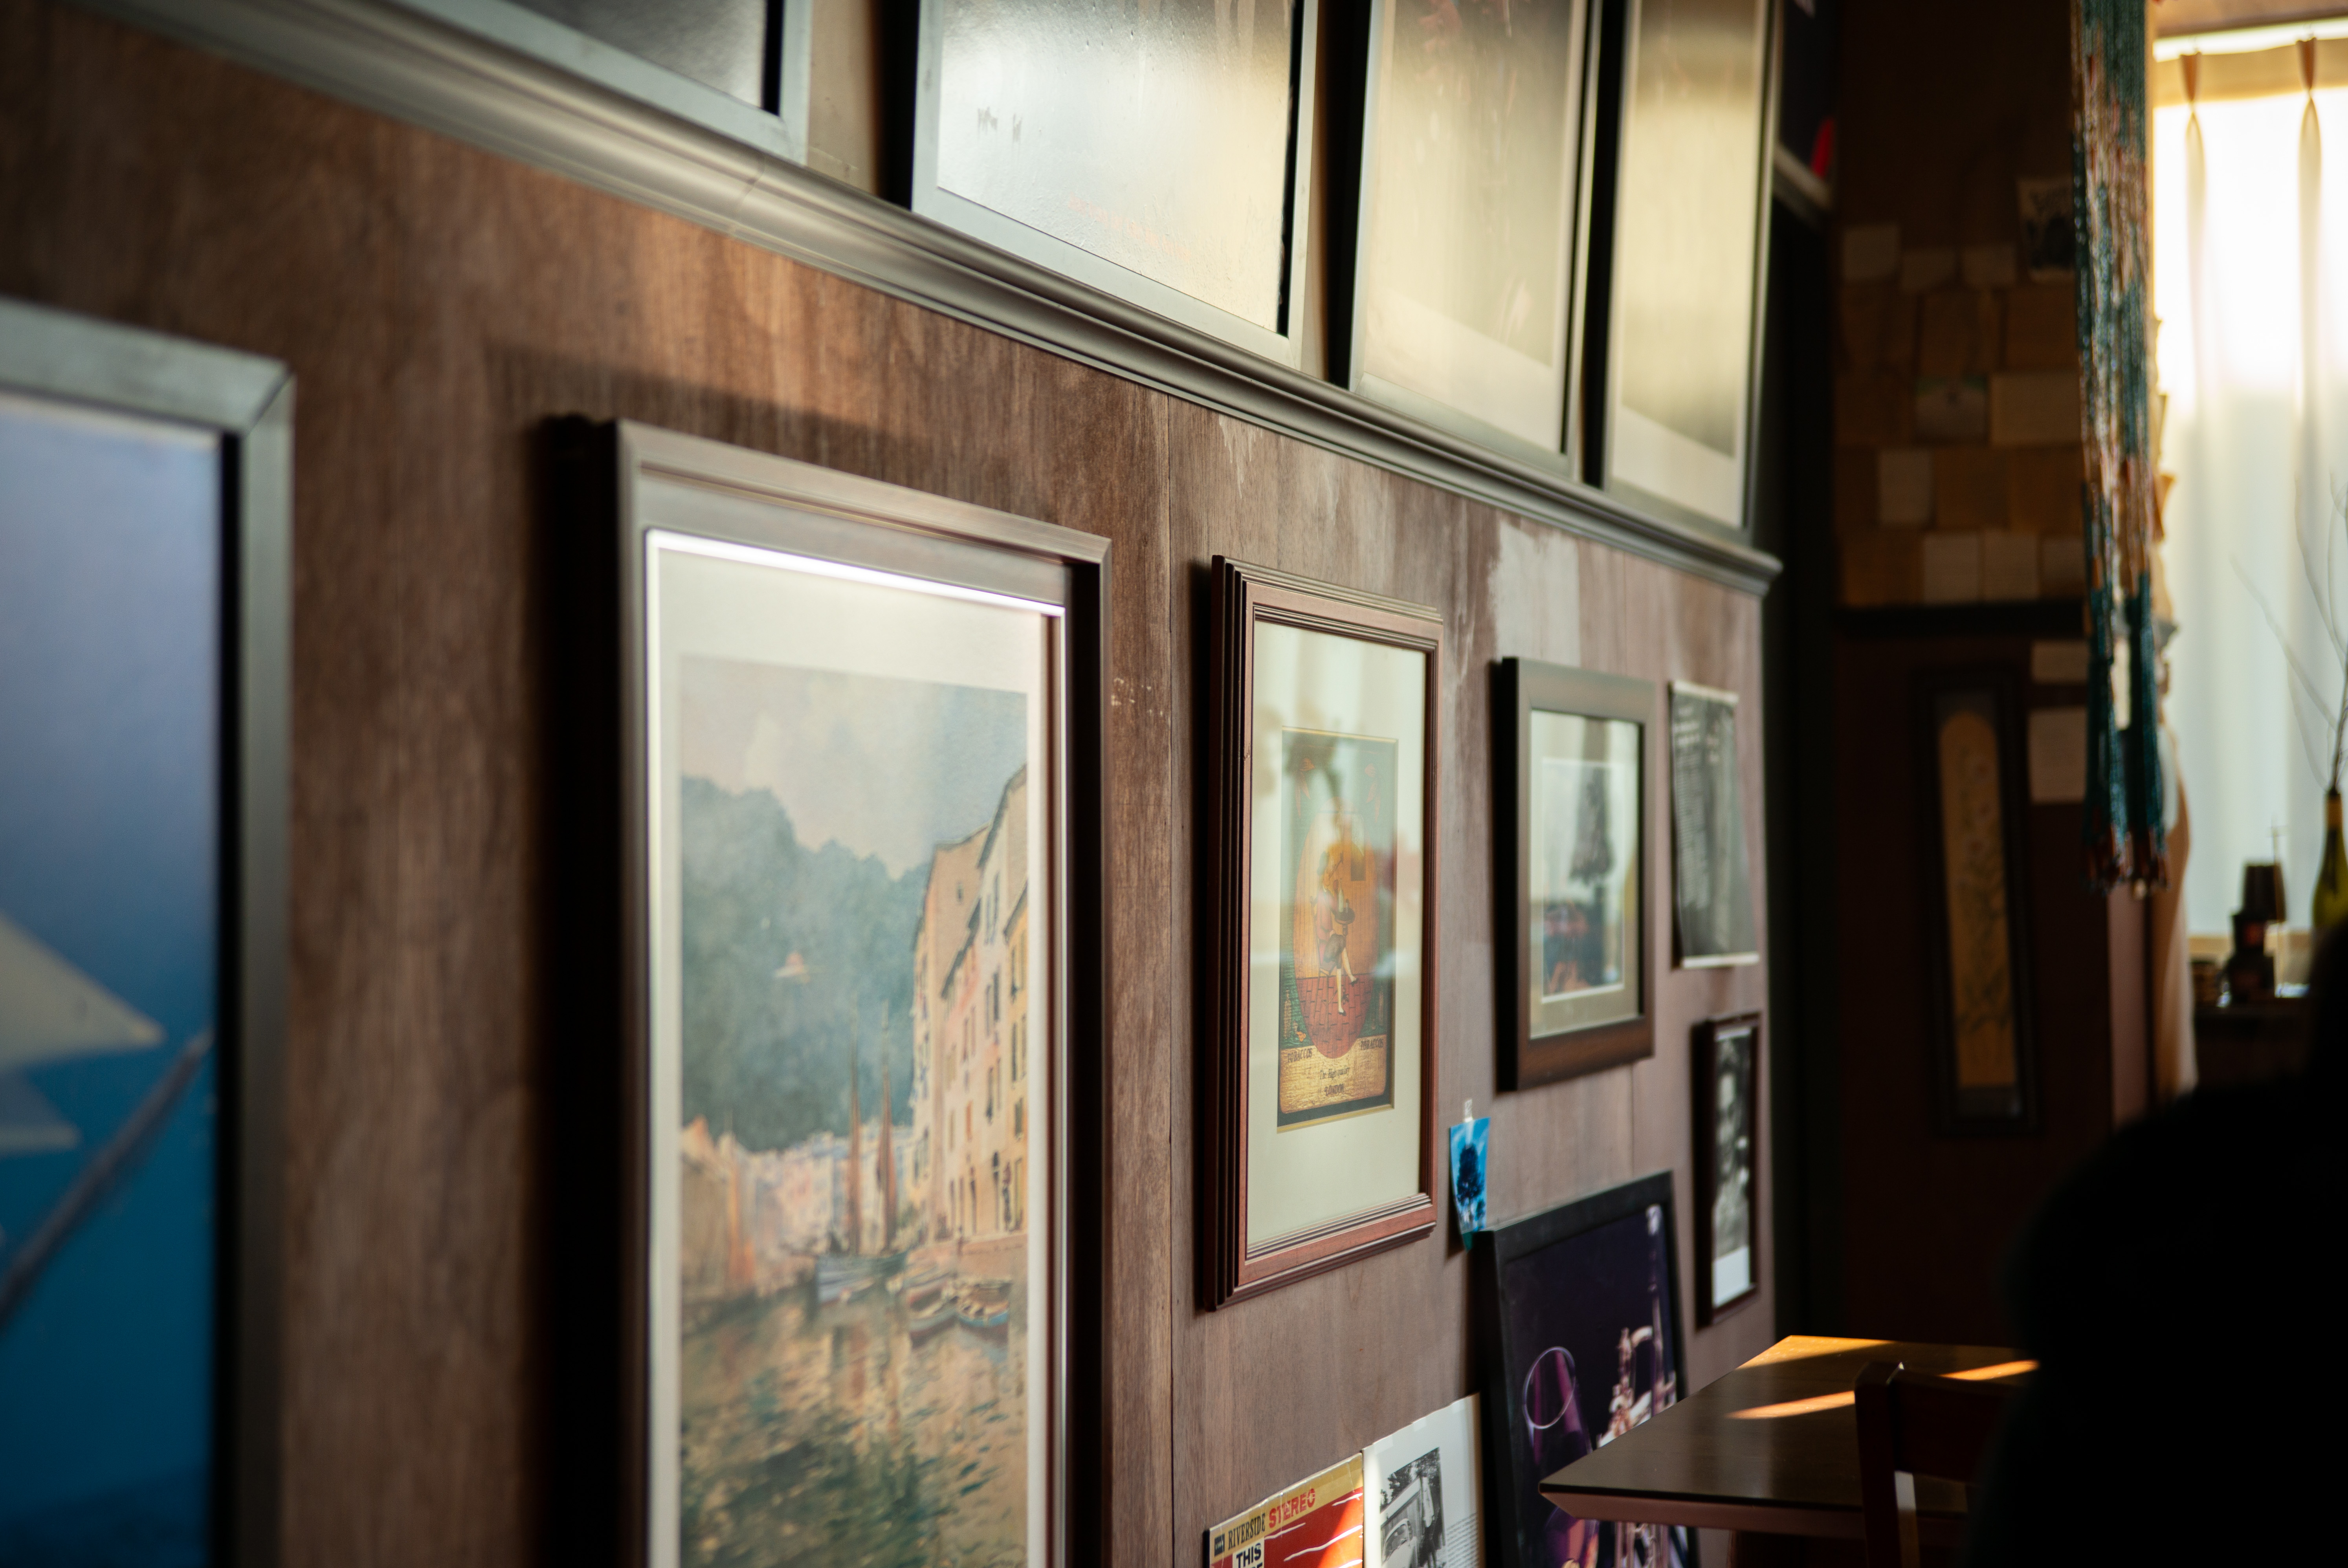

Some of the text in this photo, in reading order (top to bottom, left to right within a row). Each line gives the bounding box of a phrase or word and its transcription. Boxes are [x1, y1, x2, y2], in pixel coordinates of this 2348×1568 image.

[1287, 1048, 1313, 1063] TOBACCOS
[1324, 1083, 1345, 1096] LONDON
[1228, 1513, 1266, 1550] RIVERSIDE
[1269, 1488, 1315, 1528] STEREO
[1236, 1542, 1262, 1568] THIS
